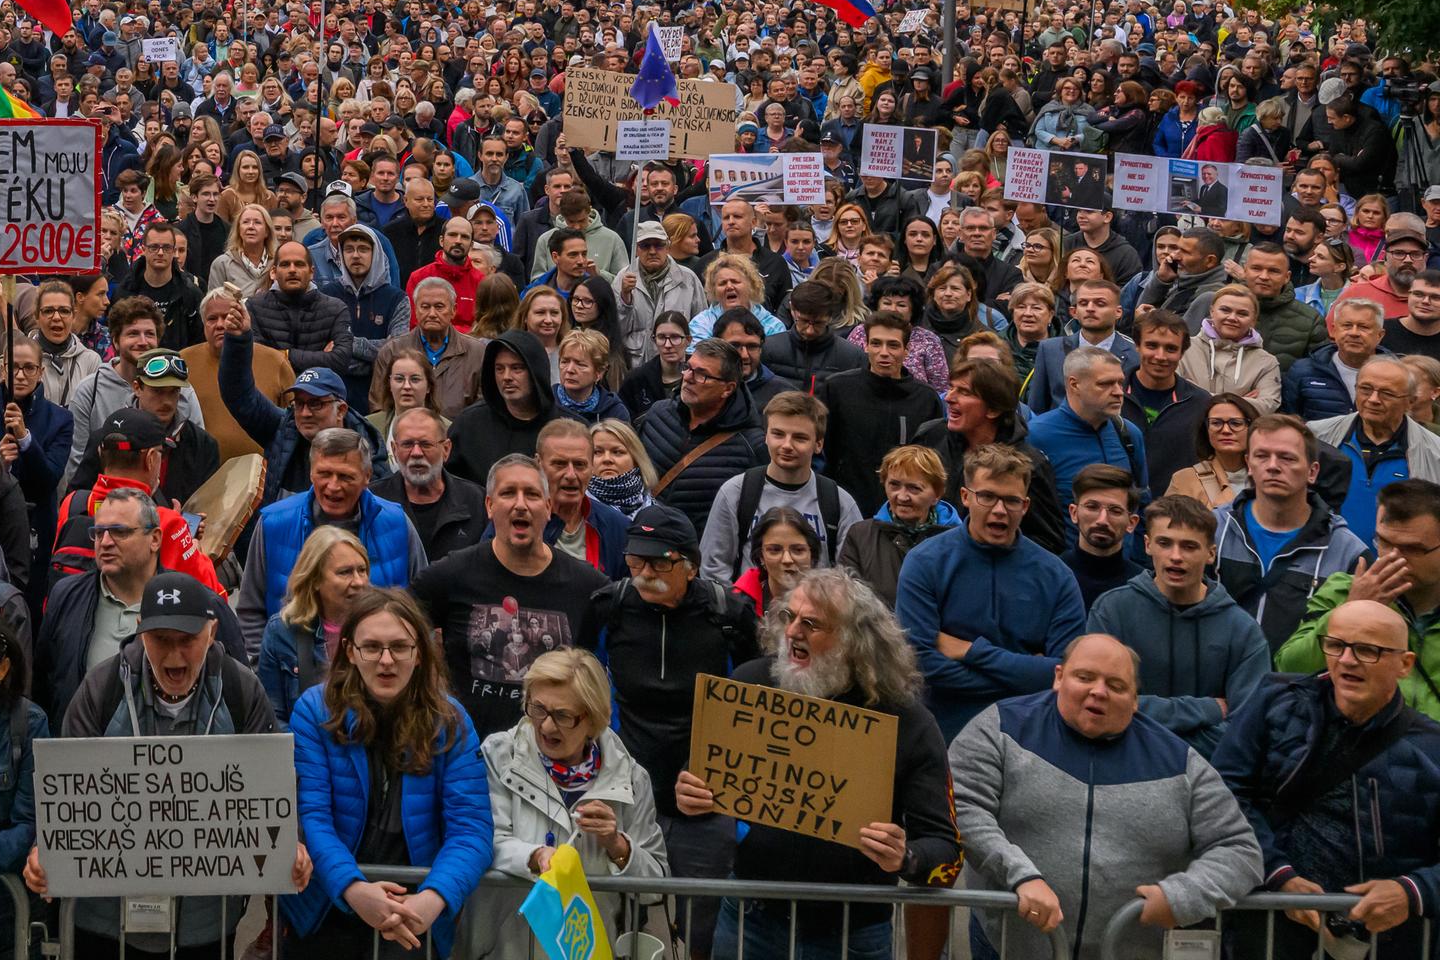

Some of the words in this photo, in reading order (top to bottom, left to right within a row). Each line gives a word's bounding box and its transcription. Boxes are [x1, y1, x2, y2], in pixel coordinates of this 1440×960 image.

[614, 76, 636, 84] VZDO
[44, 152, 89, 175] MOJU
[706, 679, 880, 734] KOLABORANT
[732, 710, 816, 746] FICO
[133, 744, 183, 766] FICO
[707, 743, 847, 794] PUTINOV
[42, 767, 140, 796] STRAŠNE
[145, 772, 175, 794] SA
[180, 763, 245, 793] BOJÍŠ
[703, 767, 836, 813] TRÓJSKÝ
[40, 800, 102, 823] TOHO
[111, 795, 142, 823] ČO
[149, 794, 205, 822] PRÍDE.
[208, 799, 222, 821] A
[225, 797, 291, 820] PRETO
[42, 823, 136, 851] VRIESKAŠ
[144, 828, 184, 850] AKO
[193, 820, 260, 849] PAVIÁN
[73, 850, 128, 879] TAKÁ
[135, 856, 164, 878] JE
[170, 854, 246, 878] PRAVDA
